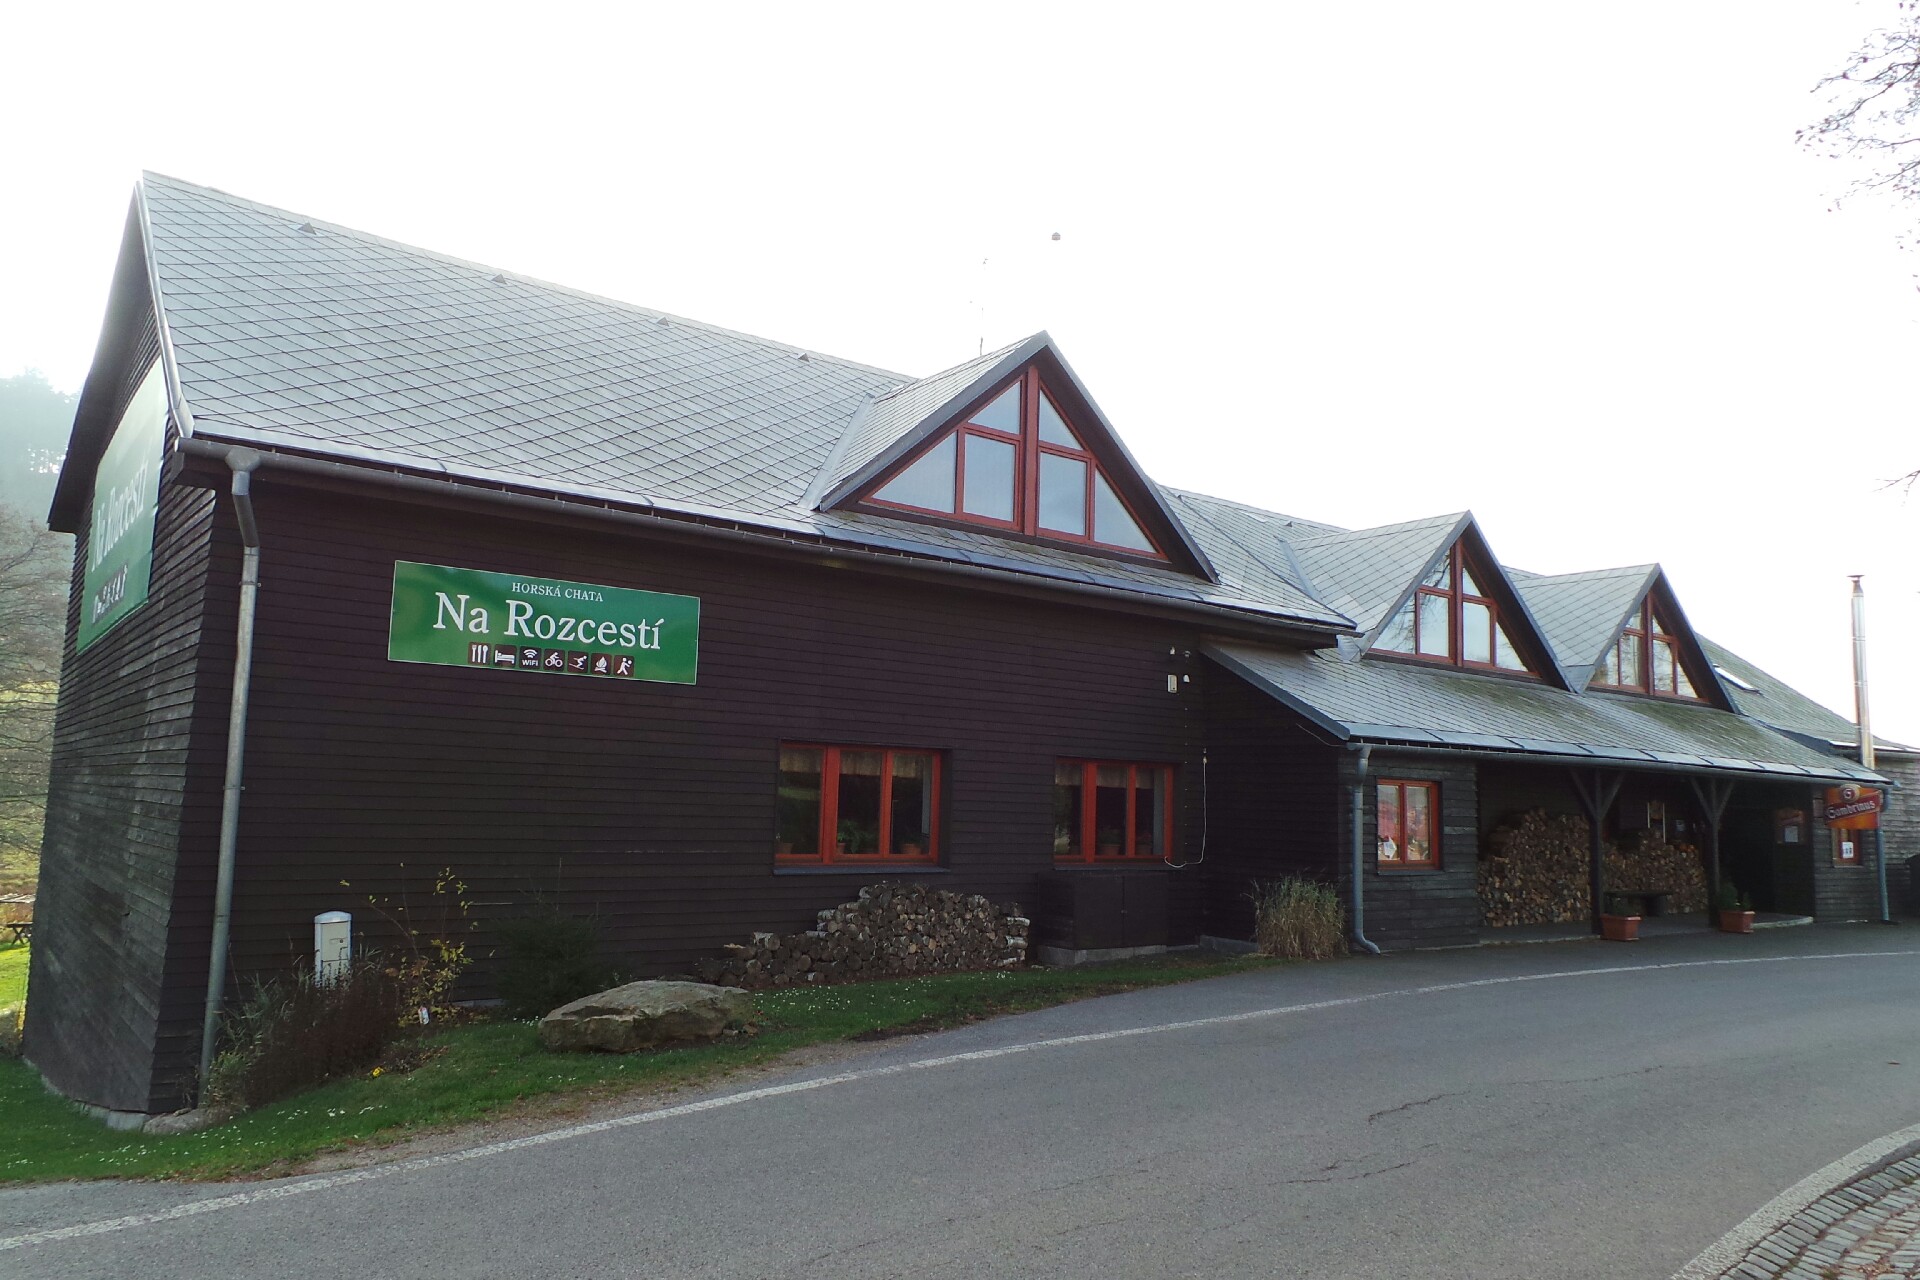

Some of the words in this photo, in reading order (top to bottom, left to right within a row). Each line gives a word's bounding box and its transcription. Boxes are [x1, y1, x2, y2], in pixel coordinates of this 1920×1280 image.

[512, 582, 561, 597] HORSKÁ
[564, 588, 603, 602] CHATA
[432, 591, 490, 634] Na
[503, 599, 665, 650] Rozcestí
